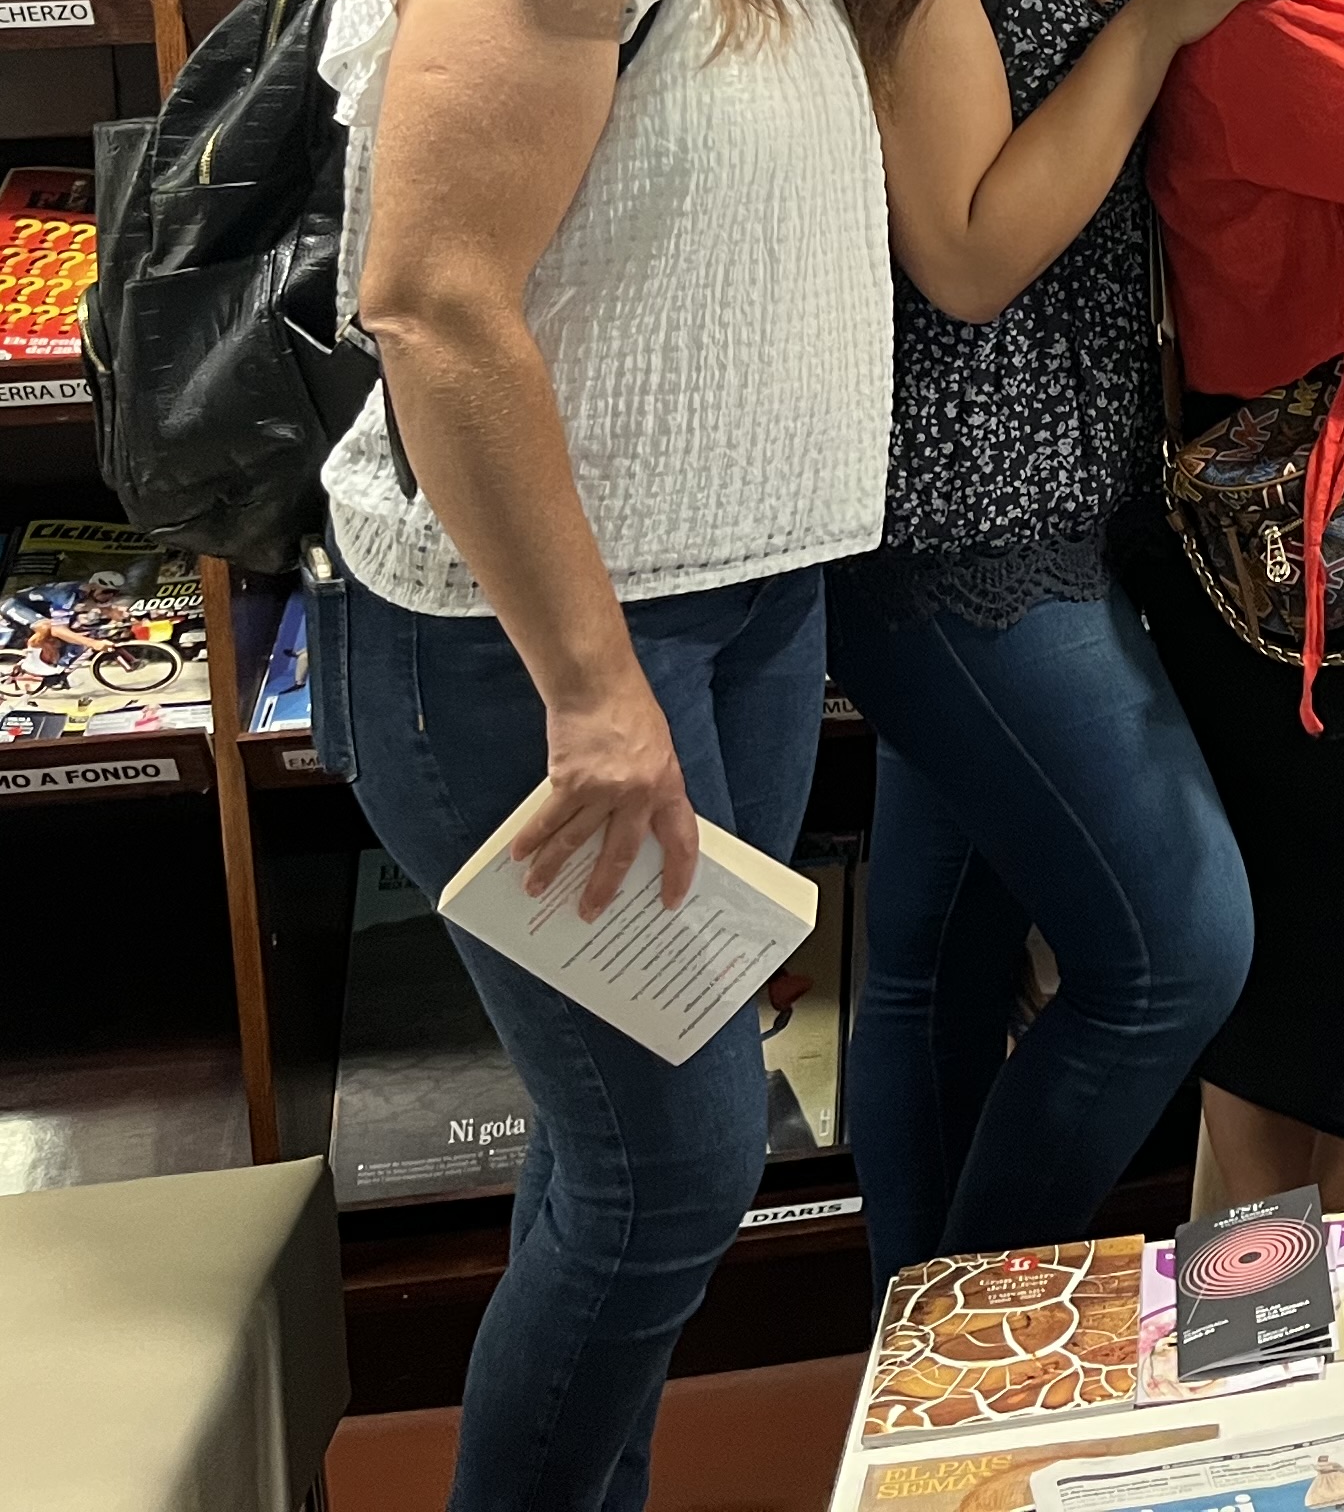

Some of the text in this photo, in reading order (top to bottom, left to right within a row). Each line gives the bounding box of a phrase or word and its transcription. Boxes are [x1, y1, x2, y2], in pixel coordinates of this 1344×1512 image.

[41, 772, 58, 786] A
[65, 763, 161, 785] FONDO
[448, 1113, 526, 1147] Ni gota
[751, 1202, 843, 1225] DIARIS
[876, 1471, 993, 1500] SEMA
[884, 1465, 931, 1484] EL
